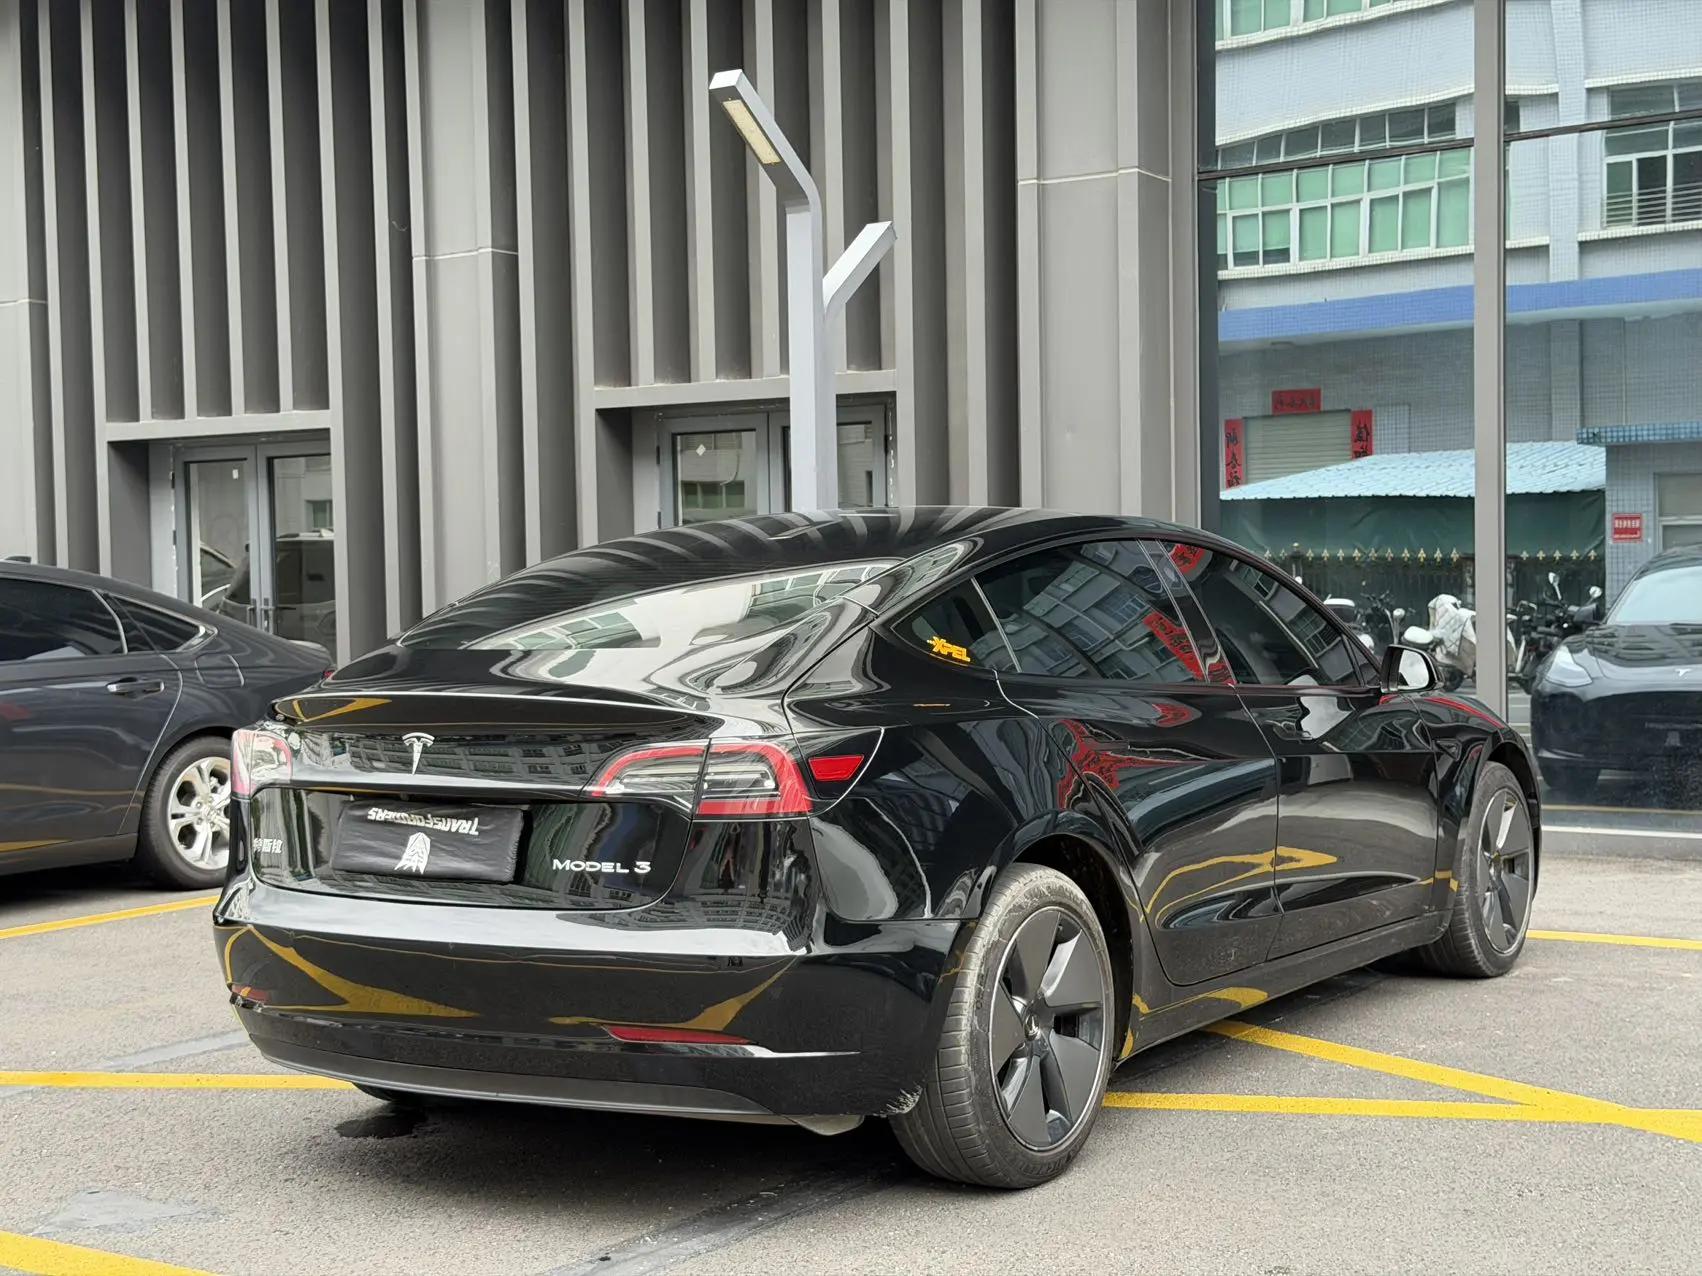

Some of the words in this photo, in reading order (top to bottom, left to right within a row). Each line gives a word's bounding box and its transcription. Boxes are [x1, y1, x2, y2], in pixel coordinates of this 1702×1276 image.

[926, 635, 971, 663] XPEL
[552, 858, 630, 873] MODEL
[633, 860, 652, 874] 3
